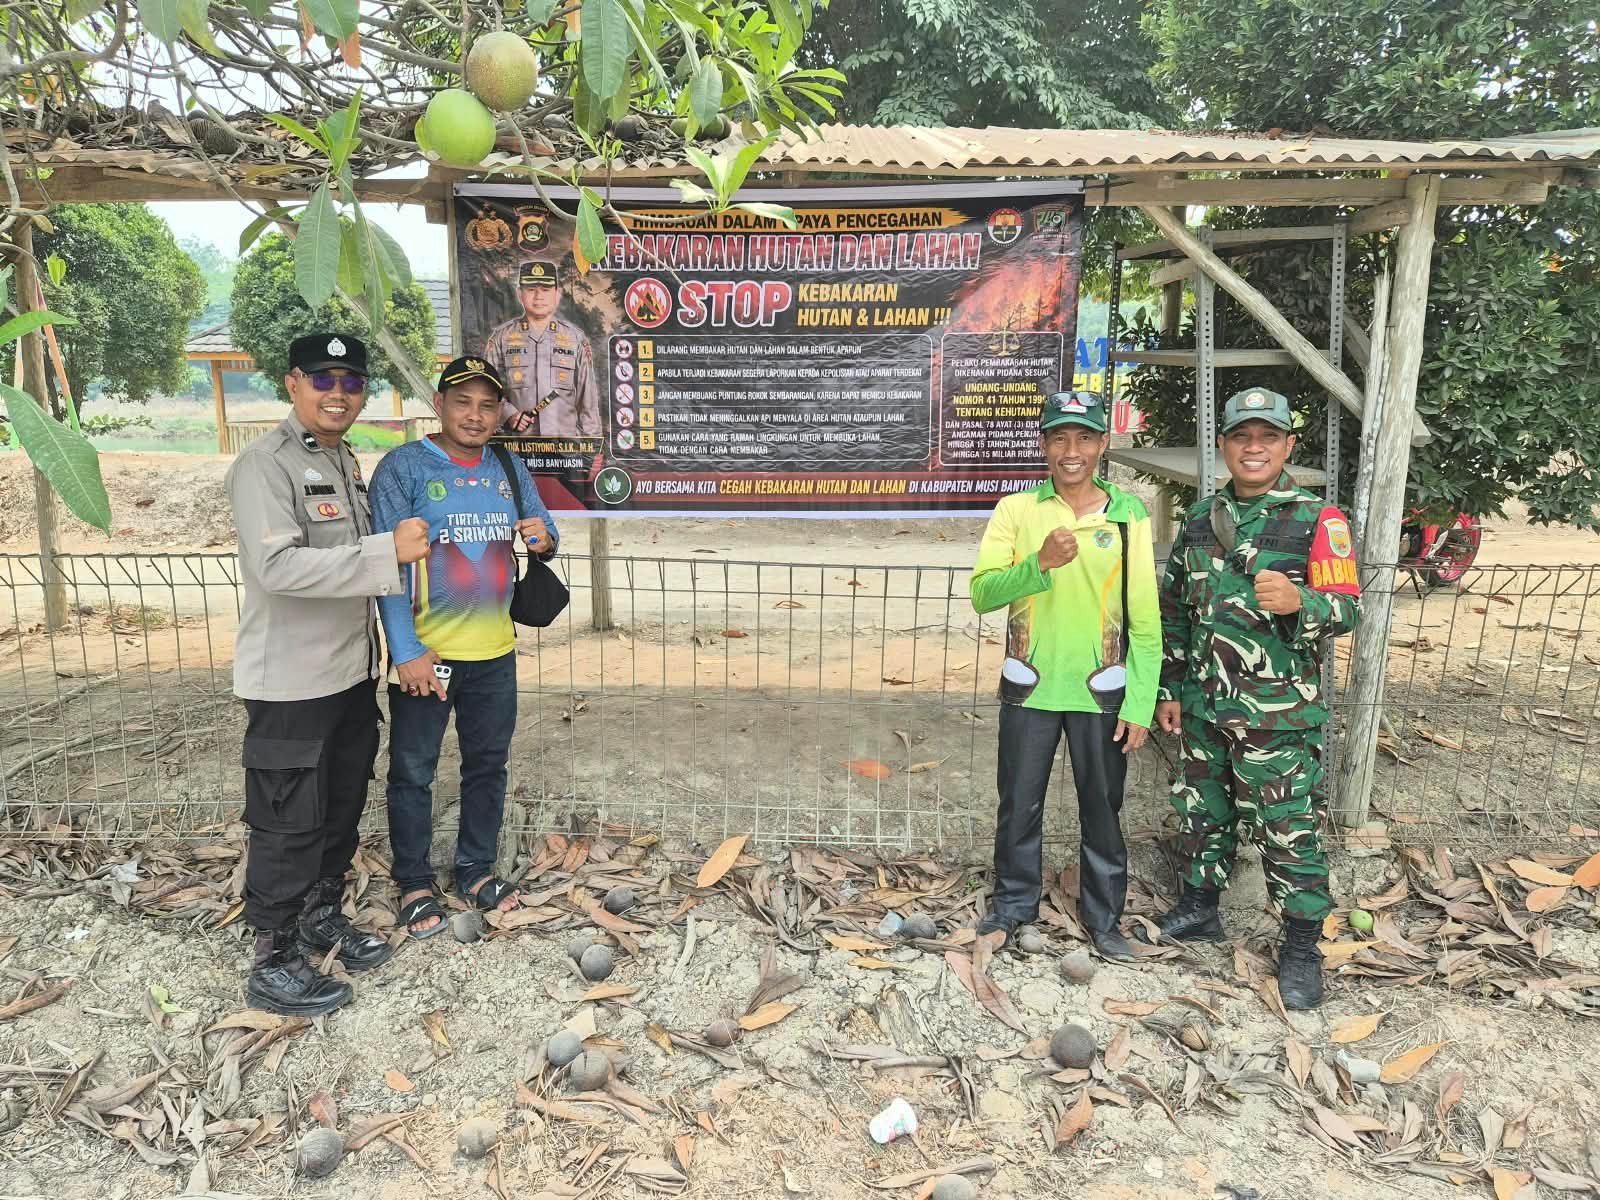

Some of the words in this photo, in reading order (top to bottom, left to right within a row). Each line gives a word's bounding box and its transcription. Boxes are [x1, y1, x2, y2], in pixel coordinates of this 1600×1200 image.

[722, 214, 777, 230] DALAM
[782, 213, 831, 230] PAYA
[836, 211, 943, 229] PENCEGAHAN
[590, 234, 745, 272] EBAKARAN
[747, 234, 834, 272] HUTAN
[837, 233, 895, 272] DAN
[895, 232, 982, 271] LAHAN
[798, 283, 899, 302] KEBAKARAN
[676, 280, 792, 328] STOP
[797, 308, 854, 327] HUTAN
[856, 308, 869, 326] &
[873, 307, 930, 326] LAHAN
[933, 307, 952, 326] !!!
[656, 345, 688, 355] DILARANG
[690, 345, 726, 355] MEMBAKAR
[727, 345, 748, 355] HUTAN
[750, 345, 763, 355] DAN
[764, 345, 785, 355] LAHAN
[787, 345, 809, 355] DALAM
[810, 345, 835, 355] BENTUK
[837, 345, 862, 355] APAPUN
[657, 368, 682, 378] APABILA
[683, 368, 706, 378] TERJADI
[707, 368, 741, 378] KEBAKARAN
[742, 368, 766, 378] SEGERA
[767, 368, 797, 378] LAPORKAN
[798, 368, 820, 378] KEPADA
[821, 368, 854, 378] KEPOLISIAN
[855, 368, 870, 378] ATAU
[871, 368, 892, 378] APARAT
[894, 368, 922, 378] TERDEKAT
[954, 369, 995, 377] DIKENAKAN
[996, 369, 1023, 377] PIDANA
[1024, 369, 1049, 377] SESUAI
[965, 383, 1037, 393] UNDANG-UNDANG
[657, 391, 682, 400] JANGAN
[683, 391, 718, 400] MEMBUANG
[719, 391, 747, 400] PUNTUNG
[748, 391, 768, 400] ROKOK
[817, 391, 840, 400] KARENA
[841, 391, 860, 400] DAPAT
[861, 391, 886, 400] MEMICU
[887, 391, 922, 400] KEBAKARAN
[953, 395, 984, 405] NOMOR
[986, 395, 996, 404] 41
[999, 395, 1027, 404] TAHUN
[955, 407, 993, 417] TENTANG
[657, 413, 688, 423] PASTIKAN
[690, 413, 708, 423] TIDAK
[709, 413, 759, 423] MENINGGALKAN
[761, 413, 772, 423] API
[773, 413, 802, 423] MENYALA
[804, 413, 811, 423] DI
[812, 413, 829, 423] AREA
[830, 413, 851, 423] HUTAN
[853, 413, 882, 423] ATAUPUN
[883, 413, 905, 423] LAHAN
[945, 421, 960, 429] DAN
[962, 421, 984, 429] PASAL
[996, 421, 1012, 429] AYAT
[658, 433, 690, 442] GUNAKAN
[691, 433, 709, 442] CARA
[710, 433, 728, 442] YANG
[730, 433, 754, 442] RAMAH
[756, 433, 798, 442] LINGKUNGAN
[799, 433, 821, 442] UNTUK
[823, 433, 857, 442] MEMBUKA
[952, 430, 986, 438] ANCAMAN
[988, 430, 1014, 438] PIDANA
[658, 445, 678, 454] TIDAK
[680, 445, 709, 454] DENGAN
[710, 445, 728, 454] CARA
[730, 445, 768, 454] MEMBAKAR
[947, 441, 975, 449] HINGGA
[987, 440, 1010, 448] TAHUN
[1011, 440, 1027, 448] DAN
[952, 450, 980, 458] HINGGA
[982, 450, 990, 458] 15
[991, 450, 1017, 458] MILIAR
[527, 458, 544, 468] MUSI
[545, 458, 584, 468] BANYUASIN
[635, 480, 653, 494] AYO
[654, 480, 695, 494] BERSAMA
[697, 480, 717, 494] KITA
[719, 479, 752, 494] CEGAH
[754, 479, 814, 494] KEBAKARAN
[816, 479, 848, 494] HUTAN
[850, 479, 871, 494] DAN
[873, 479, 907, 494] LAHAN
[908, 480, 918, 493] DI
[920, 480, 973, 493] KABUPATEN
[975, 480, 999, 493] MUSI
[446, 513, 480, 526] TIRTA
[483, 512, 509, 525] JAYA
[439, 528, 450, 544] 2
[453, 526, 513, 543] SRIKANDI
